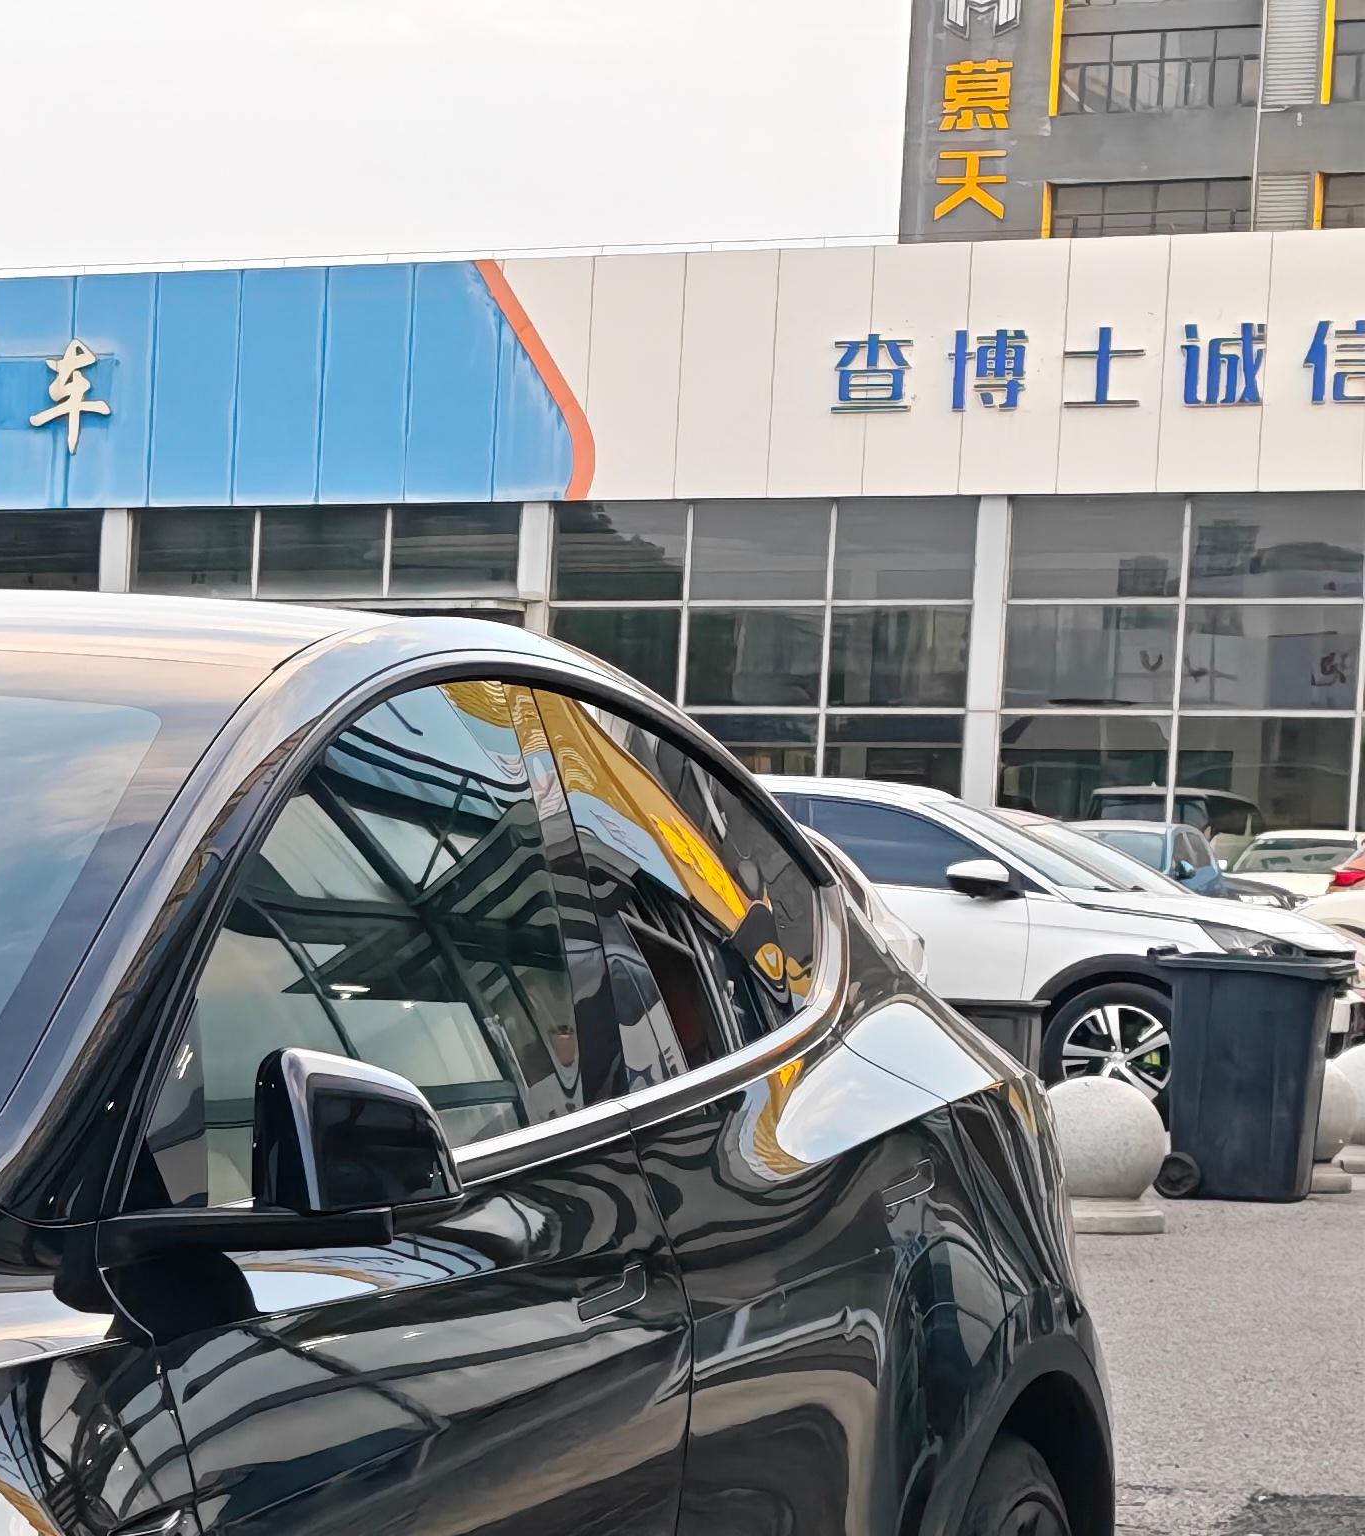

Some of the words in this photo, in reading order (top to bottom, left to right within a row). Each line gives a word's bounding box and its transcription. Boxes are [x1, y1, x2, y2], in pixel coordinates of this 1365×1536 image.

[933, 58, 1014, 222] 慕天
[830, 319, 1365, 414] 查博士诚信
